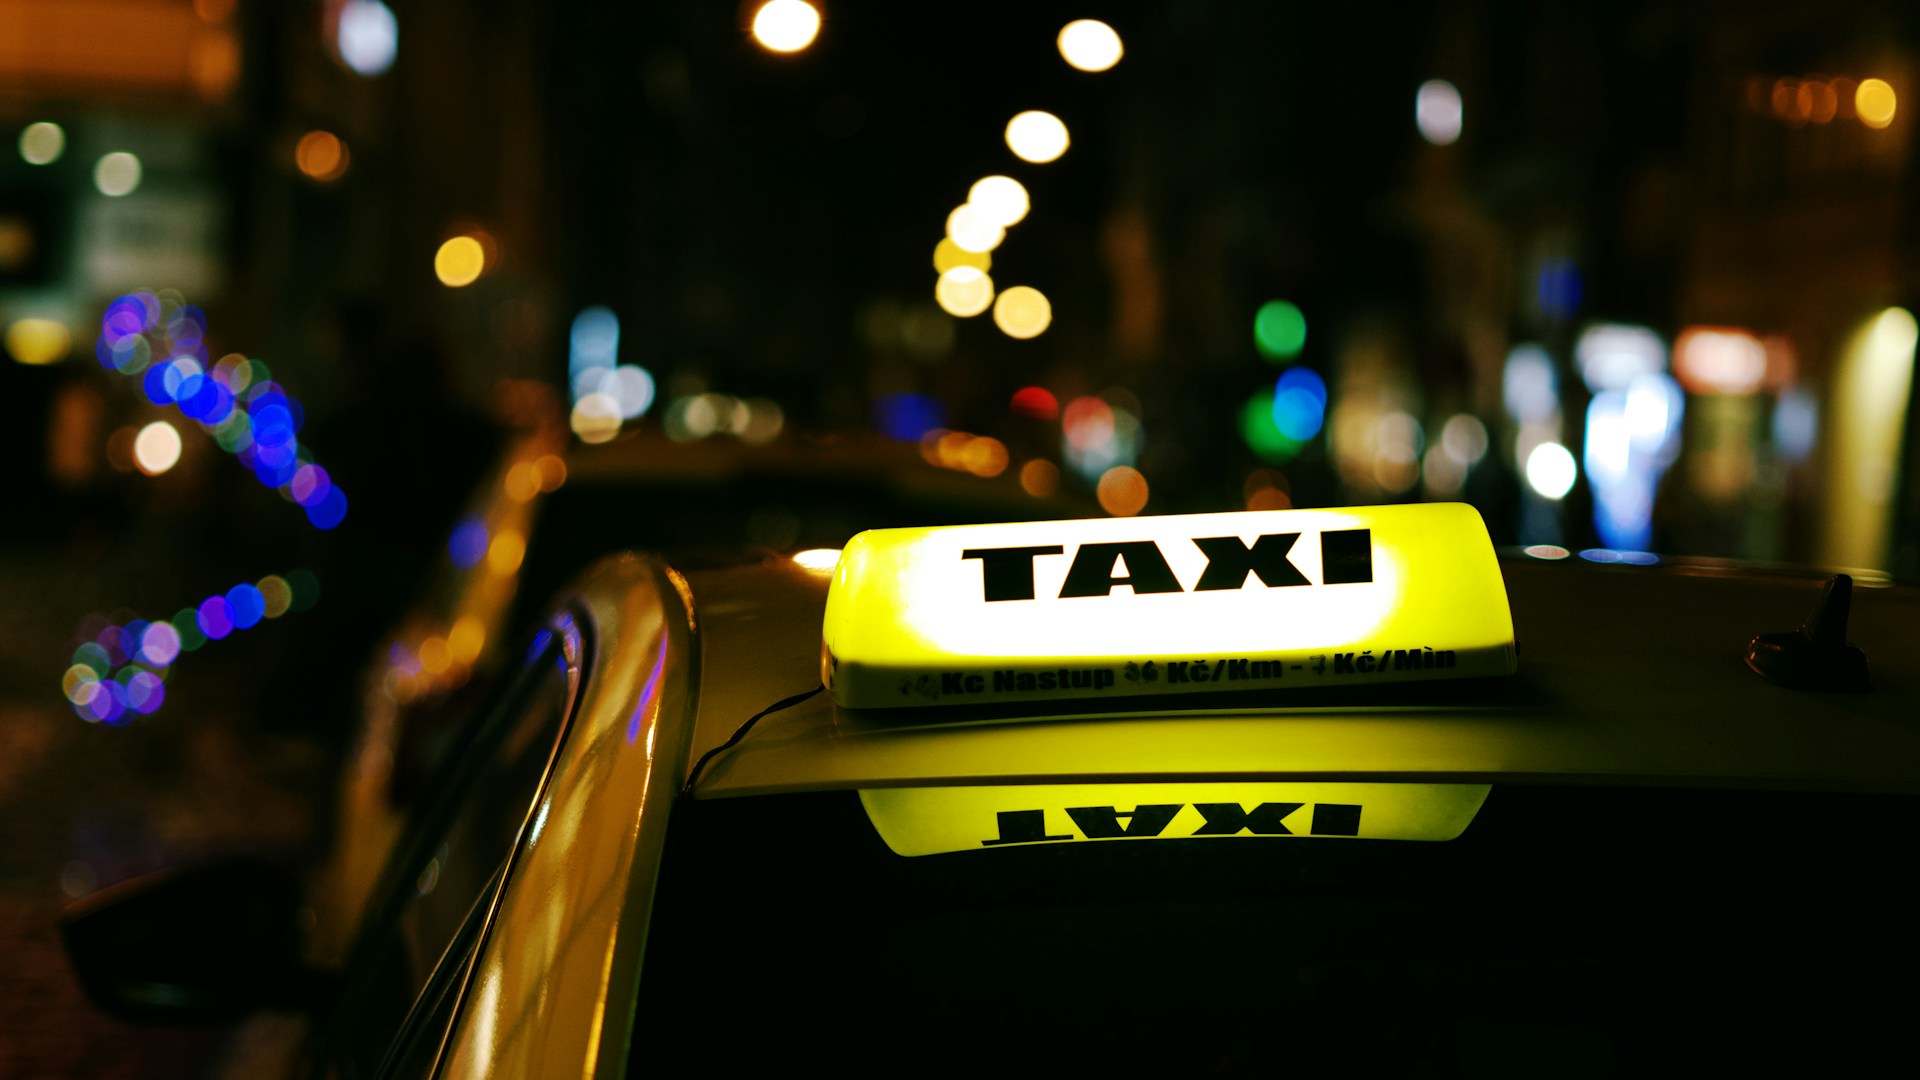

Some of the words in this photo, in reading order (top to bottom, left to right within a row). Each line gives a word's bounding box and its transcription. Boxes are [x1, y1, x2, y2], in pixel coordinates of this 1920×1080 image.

[962, 529, 1373, 602] TAXI
[994, 669, 1114, 692] Nastup
[1168, 659, 1282, 683] Kč/Km
